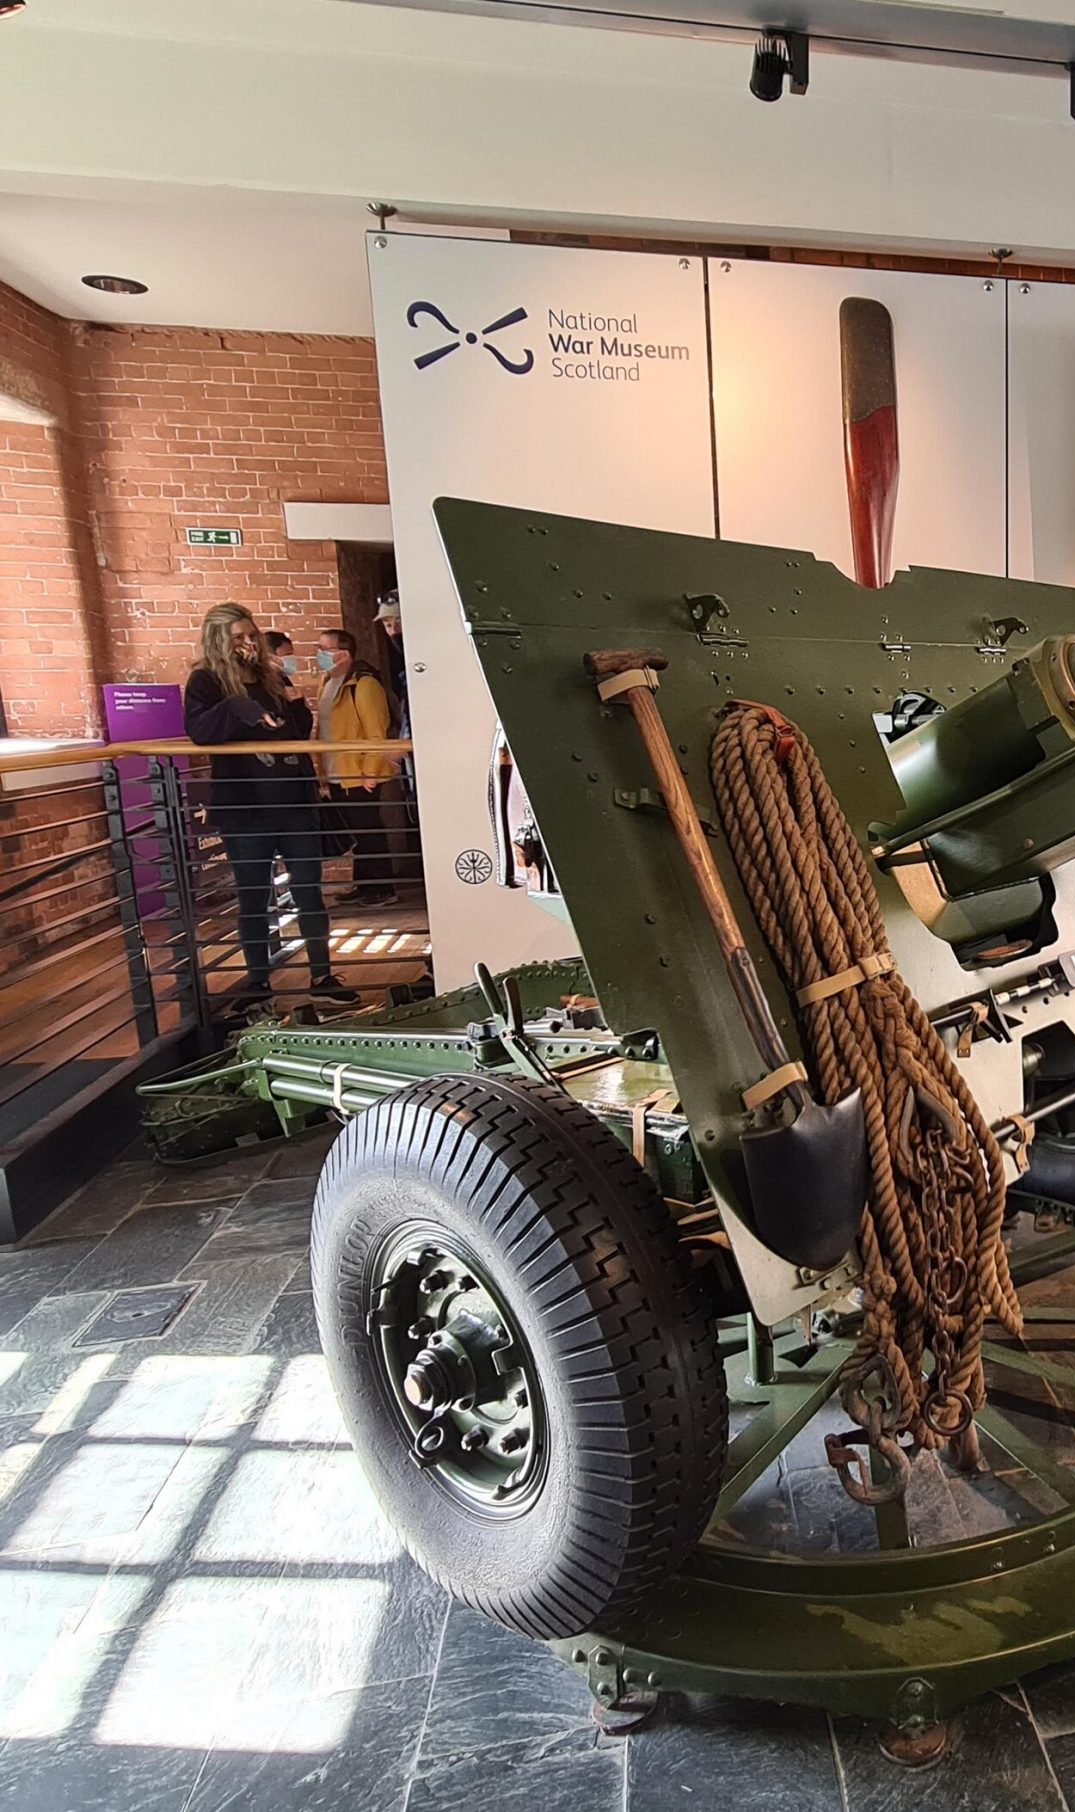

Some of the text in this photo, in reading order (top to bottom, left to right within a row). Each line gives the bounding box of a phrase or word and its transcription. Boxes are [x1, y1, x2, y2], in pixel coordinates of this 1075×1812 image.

[548, 308, 638, 334] National
[548, 333, 690, 361] War Museum
[551, 357, 640, 382] Scotland
[336, 1215, 376, 1349] DUNLOP
